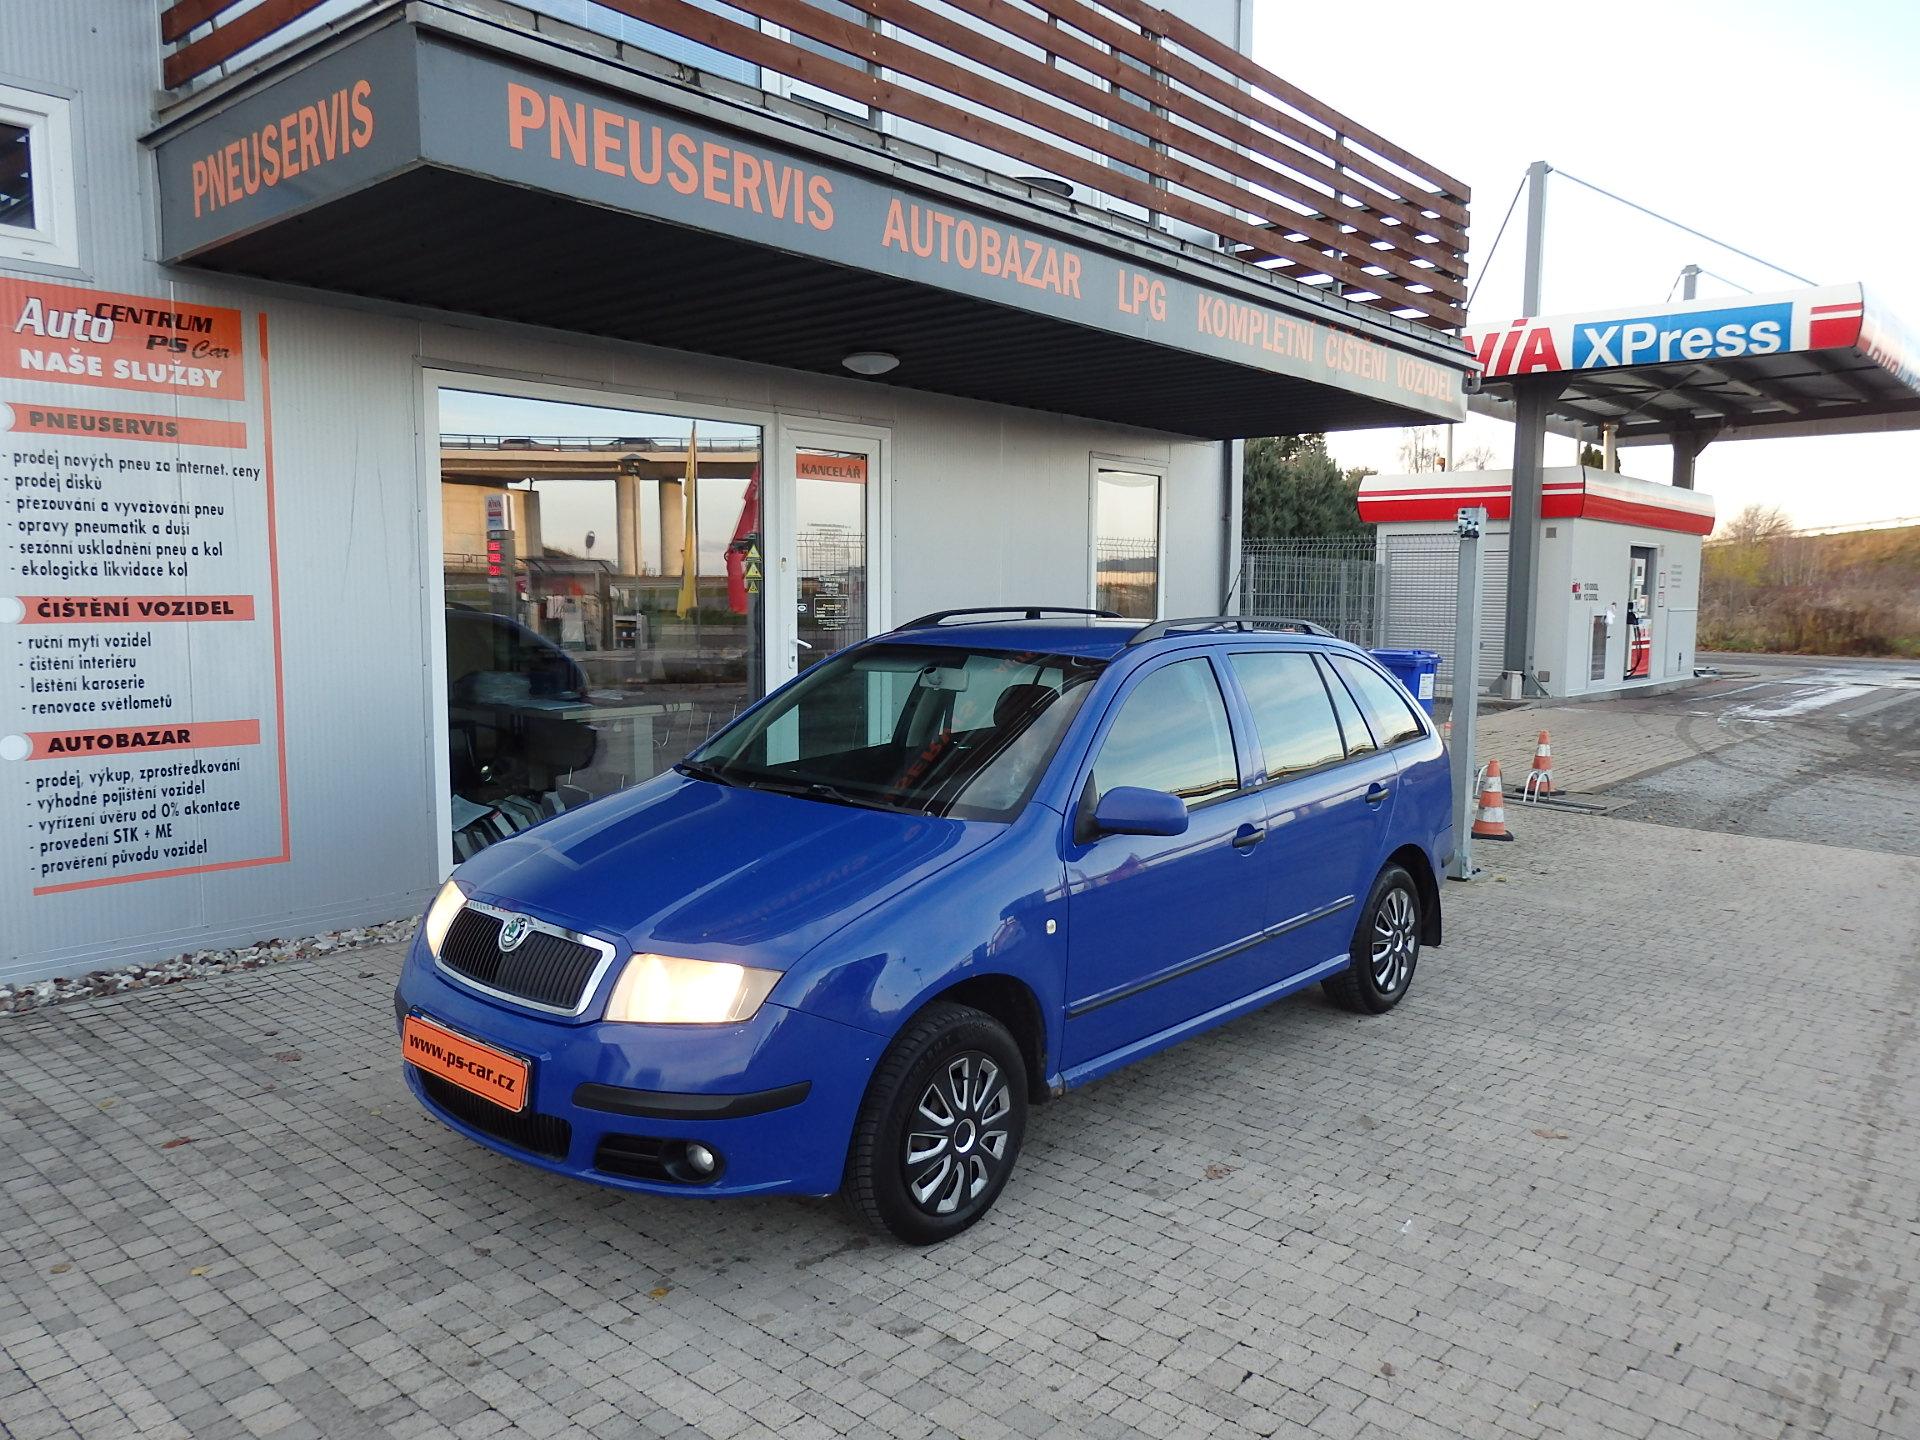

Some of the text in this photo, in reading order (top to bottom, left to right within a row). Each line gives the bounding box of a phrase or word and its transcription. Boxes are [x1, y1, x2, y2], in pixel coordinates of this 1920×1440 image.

[193, 79, 375, 218] PNEUSERVIS
[508, 82, 834, 231] PNEUSERVIS
[881, 198, 1081, 299] AUTOBAZAR
[1118, 269, 1167, 322] LPG
[1197, 293, 1318, 362] KOMPLETNÍ
[1397, 355, 1453, 402] VOZIDEL
[13, 295, 214, 344] Auto CENTRUM
[146, 334, 189, 353] PS
[1581, 319, 1783, 368] XPress
[20, 346, 222, 388] NAŠE SLUŽBY
[29, 410, 178, 437] PNEUSERVIS
[13, 449, 260, 481] prodej nových pneu za internet. ceny
[15, 472, 61, 492] prodej
[17, 496, 224, 519] přezouvání a vyvažování pneu
[18, 521, 69, 537] opravy
[75, 519, 147, 537] pneumatik
[152, 524, 160, 534] a
[20, 539, 223, 559] sezónní uskladnění pneu a kol
[22, 560, 188, 580] ekologická likvidace kol
[37, 597, 234, 618] ČIŠTĚNÍ VOZIDEL
[28, 634, 63, 649] ruční
[104, 631, 151, 648] vozidel
[30, 653, 136, 671] čištění interiéru
[31, 674, 145, 693] leštění karoserie
[32, 693, 172, 714] renovace světlometů
[48, 729, 191, 753] AUTOBAZAR
[36, 769, 84, 792] prodej,
[139, 758, 241, 782] zprostředkování
[102, 785, 157, 807] pojištění
[161, 779, 205, 798] vozidel
[39, 800, 241, 835] vyřízení úvěru od 0% akontace
[40, 832, 109, 857] provedení
[113, 827, 139, 844] STK
[155, 823, 172, 839] ME
[41, 838, 208, 878] prověření původu vozidel
[409, 1034, 516, 1093] www.ps-car.cz
